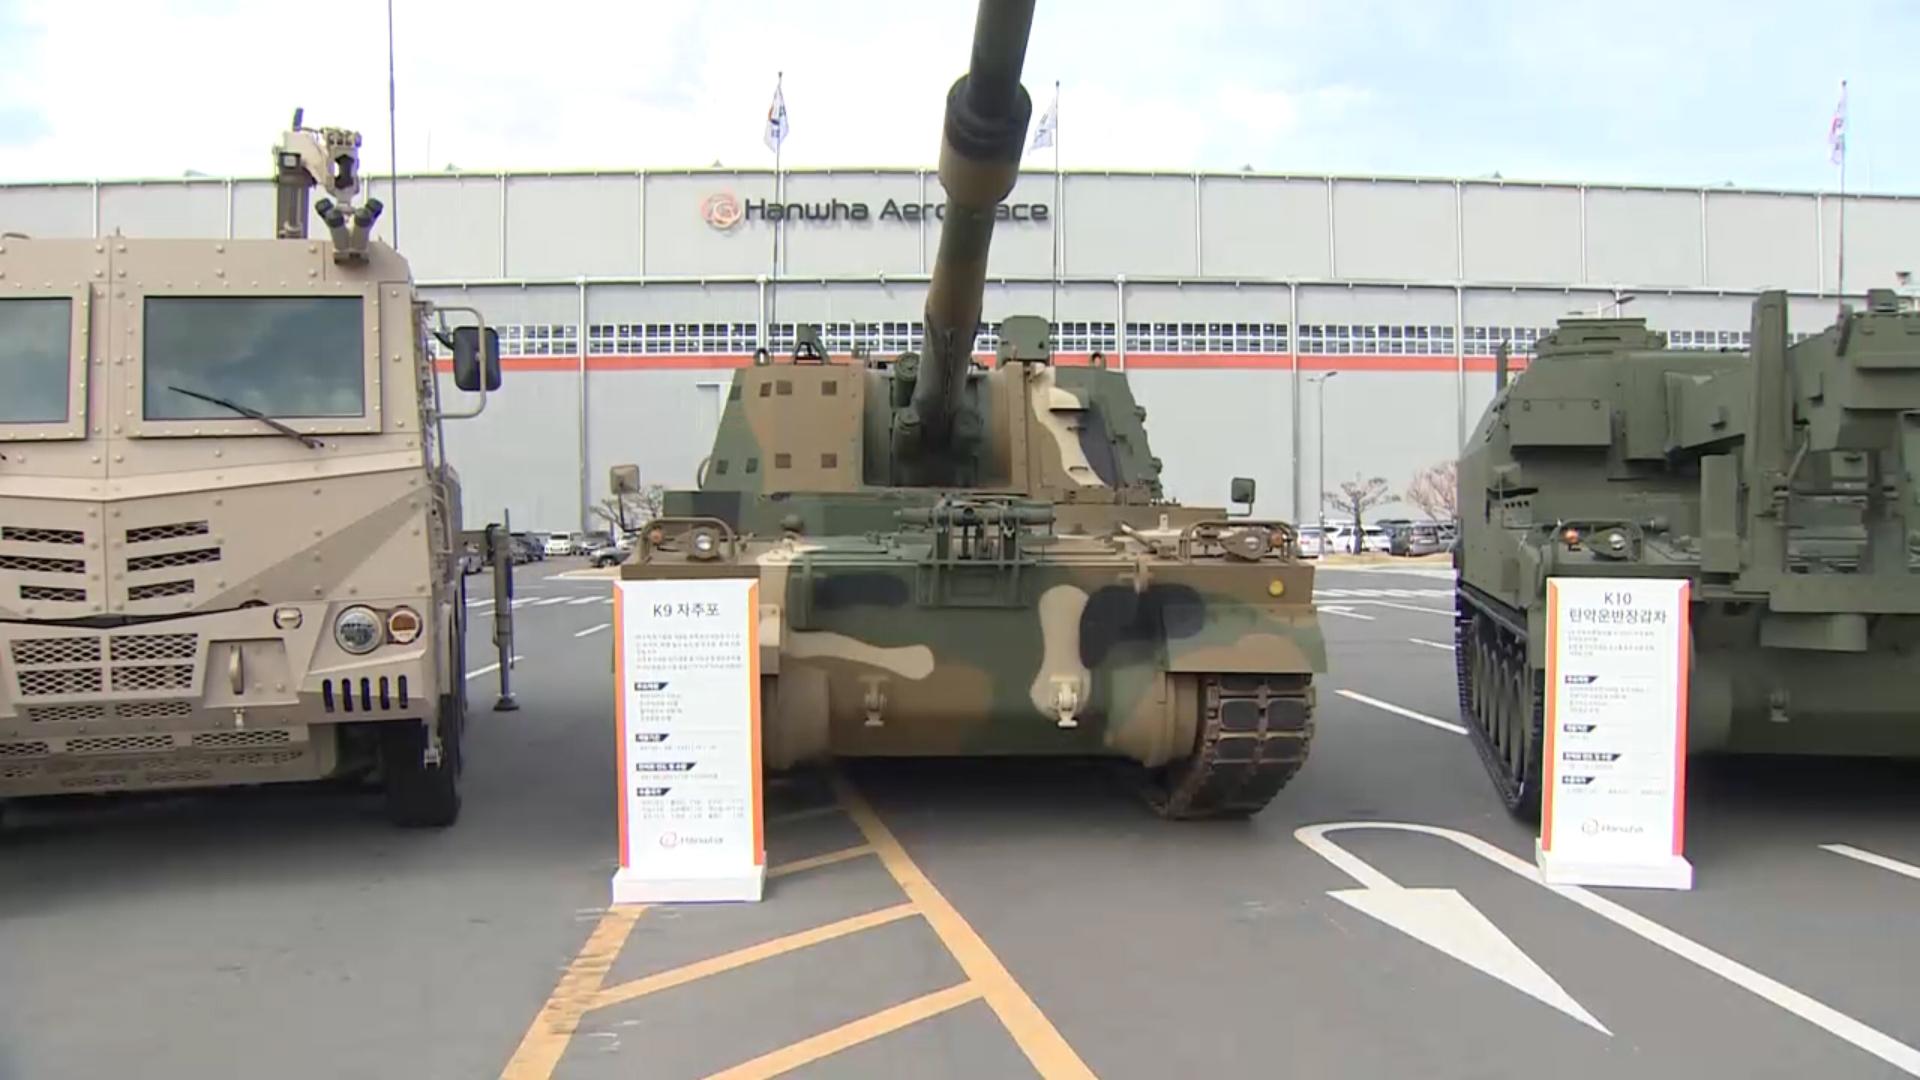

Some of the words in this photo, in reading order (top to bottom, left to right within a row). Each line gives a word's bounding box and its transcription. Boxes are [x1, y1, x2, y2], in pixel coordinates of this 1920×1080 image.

[745, 199, 867, 221] Hanwha
[881, 199, 1048, 221] Aeroace
[1604, 592, 1632, 605] K10
[653, 602, 673, 617] K9
[677, 602, 721, 617] 자주포
[1570, 608, 1667, 624] 탄약운반장갑차
